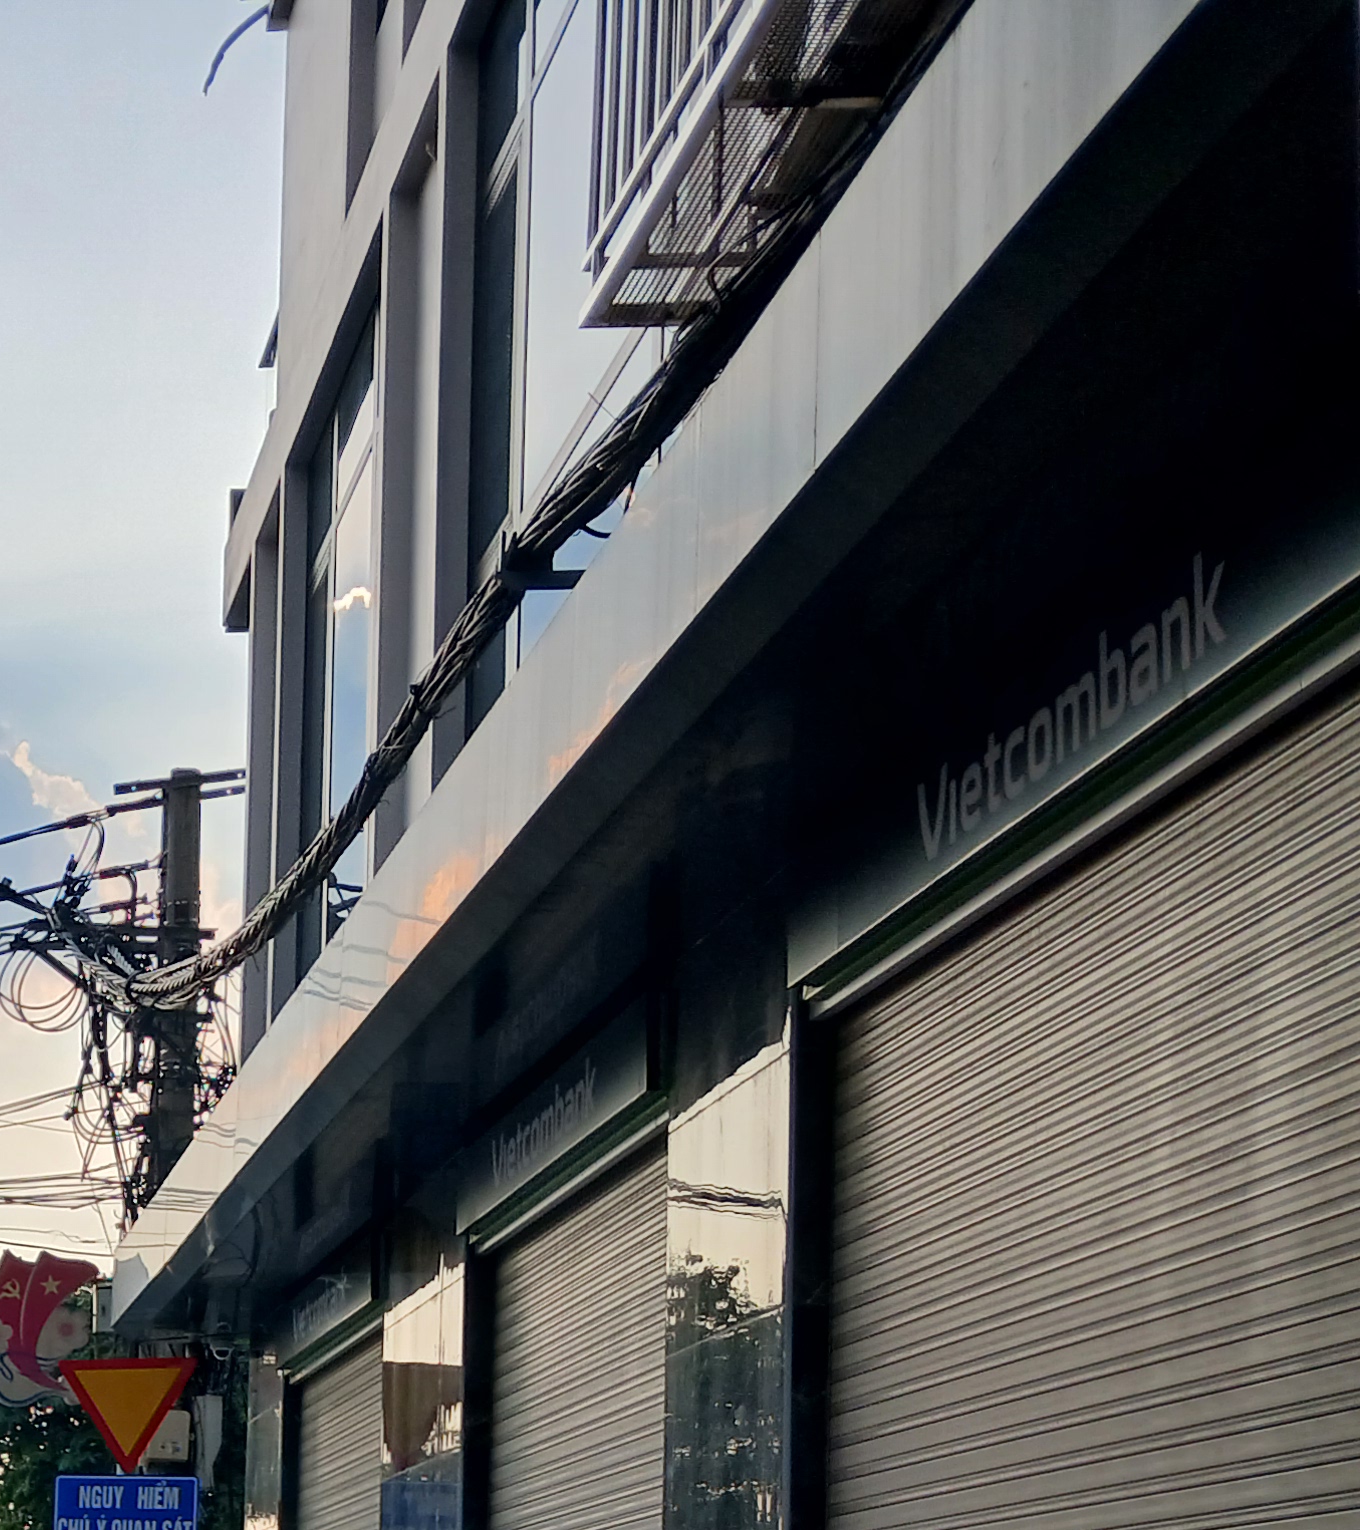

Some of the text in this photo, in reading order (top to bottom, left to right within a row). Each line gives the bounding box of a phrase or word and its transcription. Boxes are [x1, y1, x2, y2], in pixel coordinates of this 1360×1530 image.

[917, 551, 1227, 862] Vietcombank
[78, 1480, 180, 1510] NGUY HIỂM
